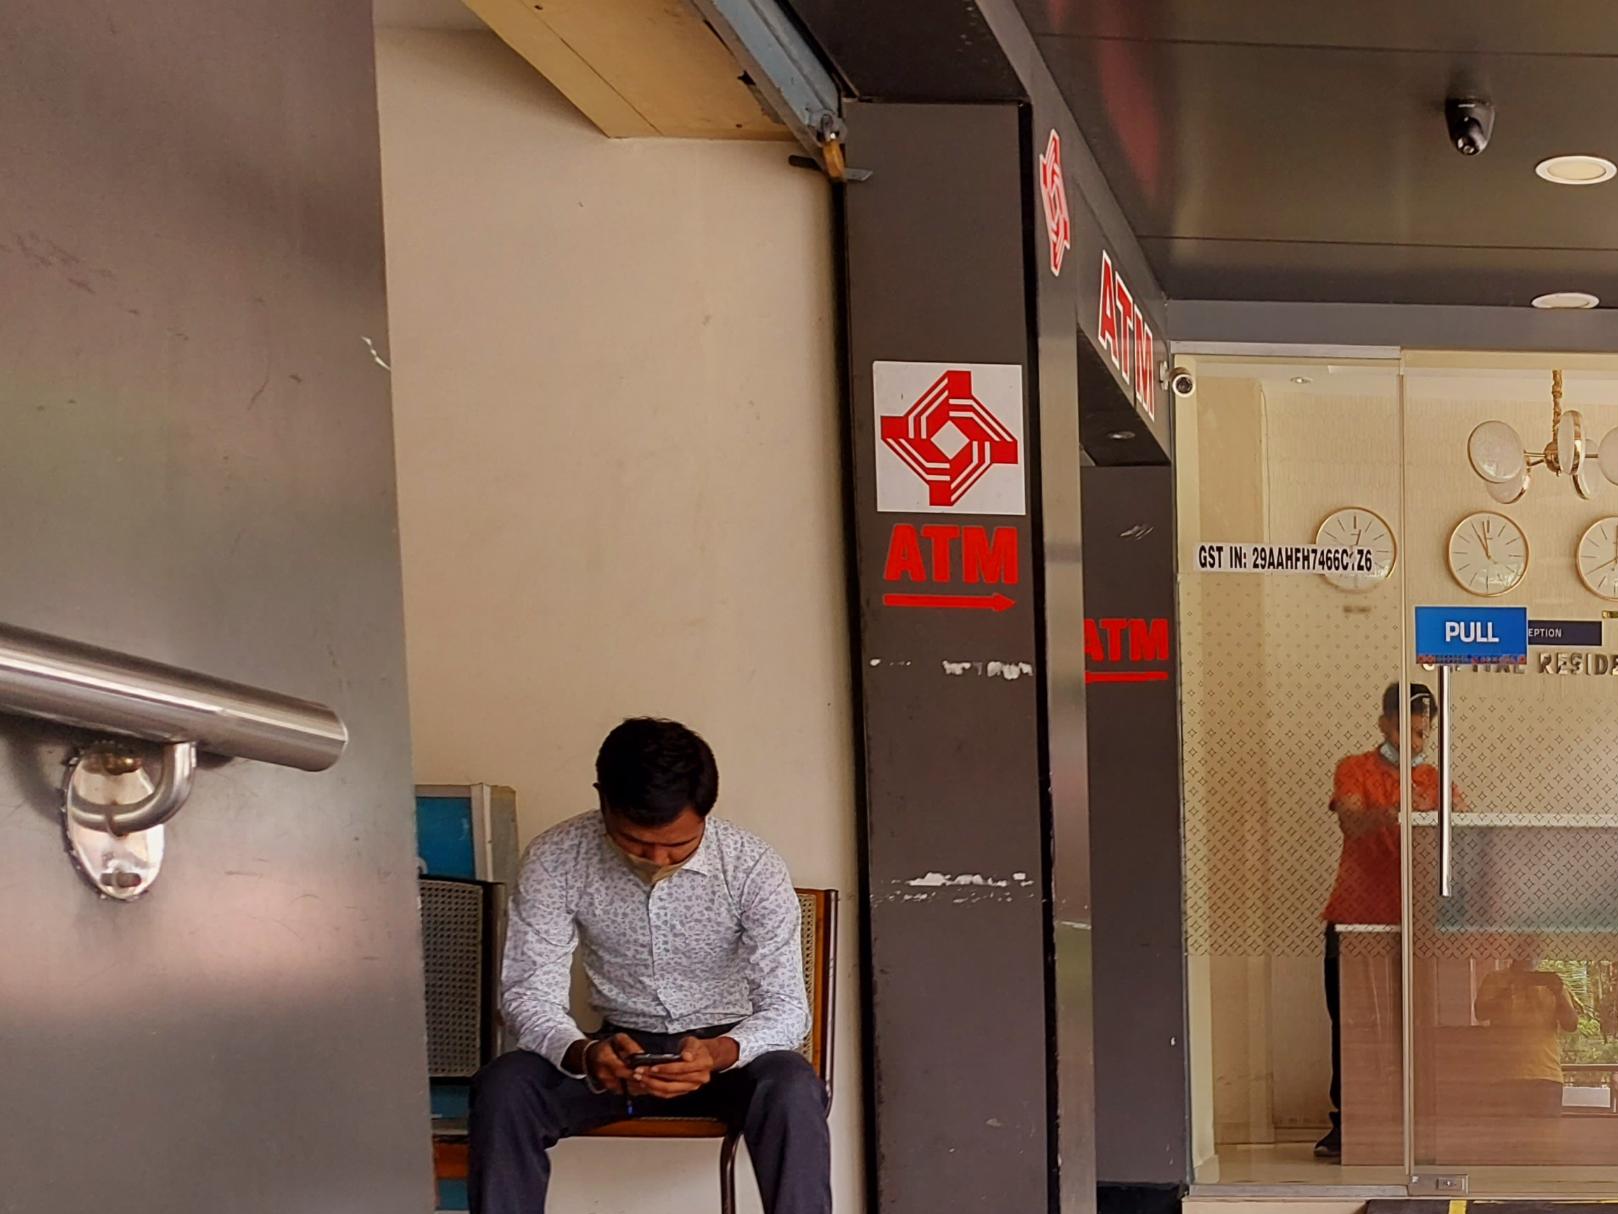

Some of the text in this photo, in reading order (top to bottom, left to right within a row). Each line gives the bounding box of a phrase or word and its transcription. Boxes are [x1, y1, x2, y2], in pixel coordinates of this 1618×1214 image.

[1098, 249, 1155, 422] ATM
[883, 523, 1019, 585] ATM
[1198, 545, 1224, 569] GST
[1229, 546, 1247, 569] IN:
[1083, 618, 1169, 662] ATM
[1445, 621, 1499, 643] PULL
[1528, 628, 1562, 639] EPTION
